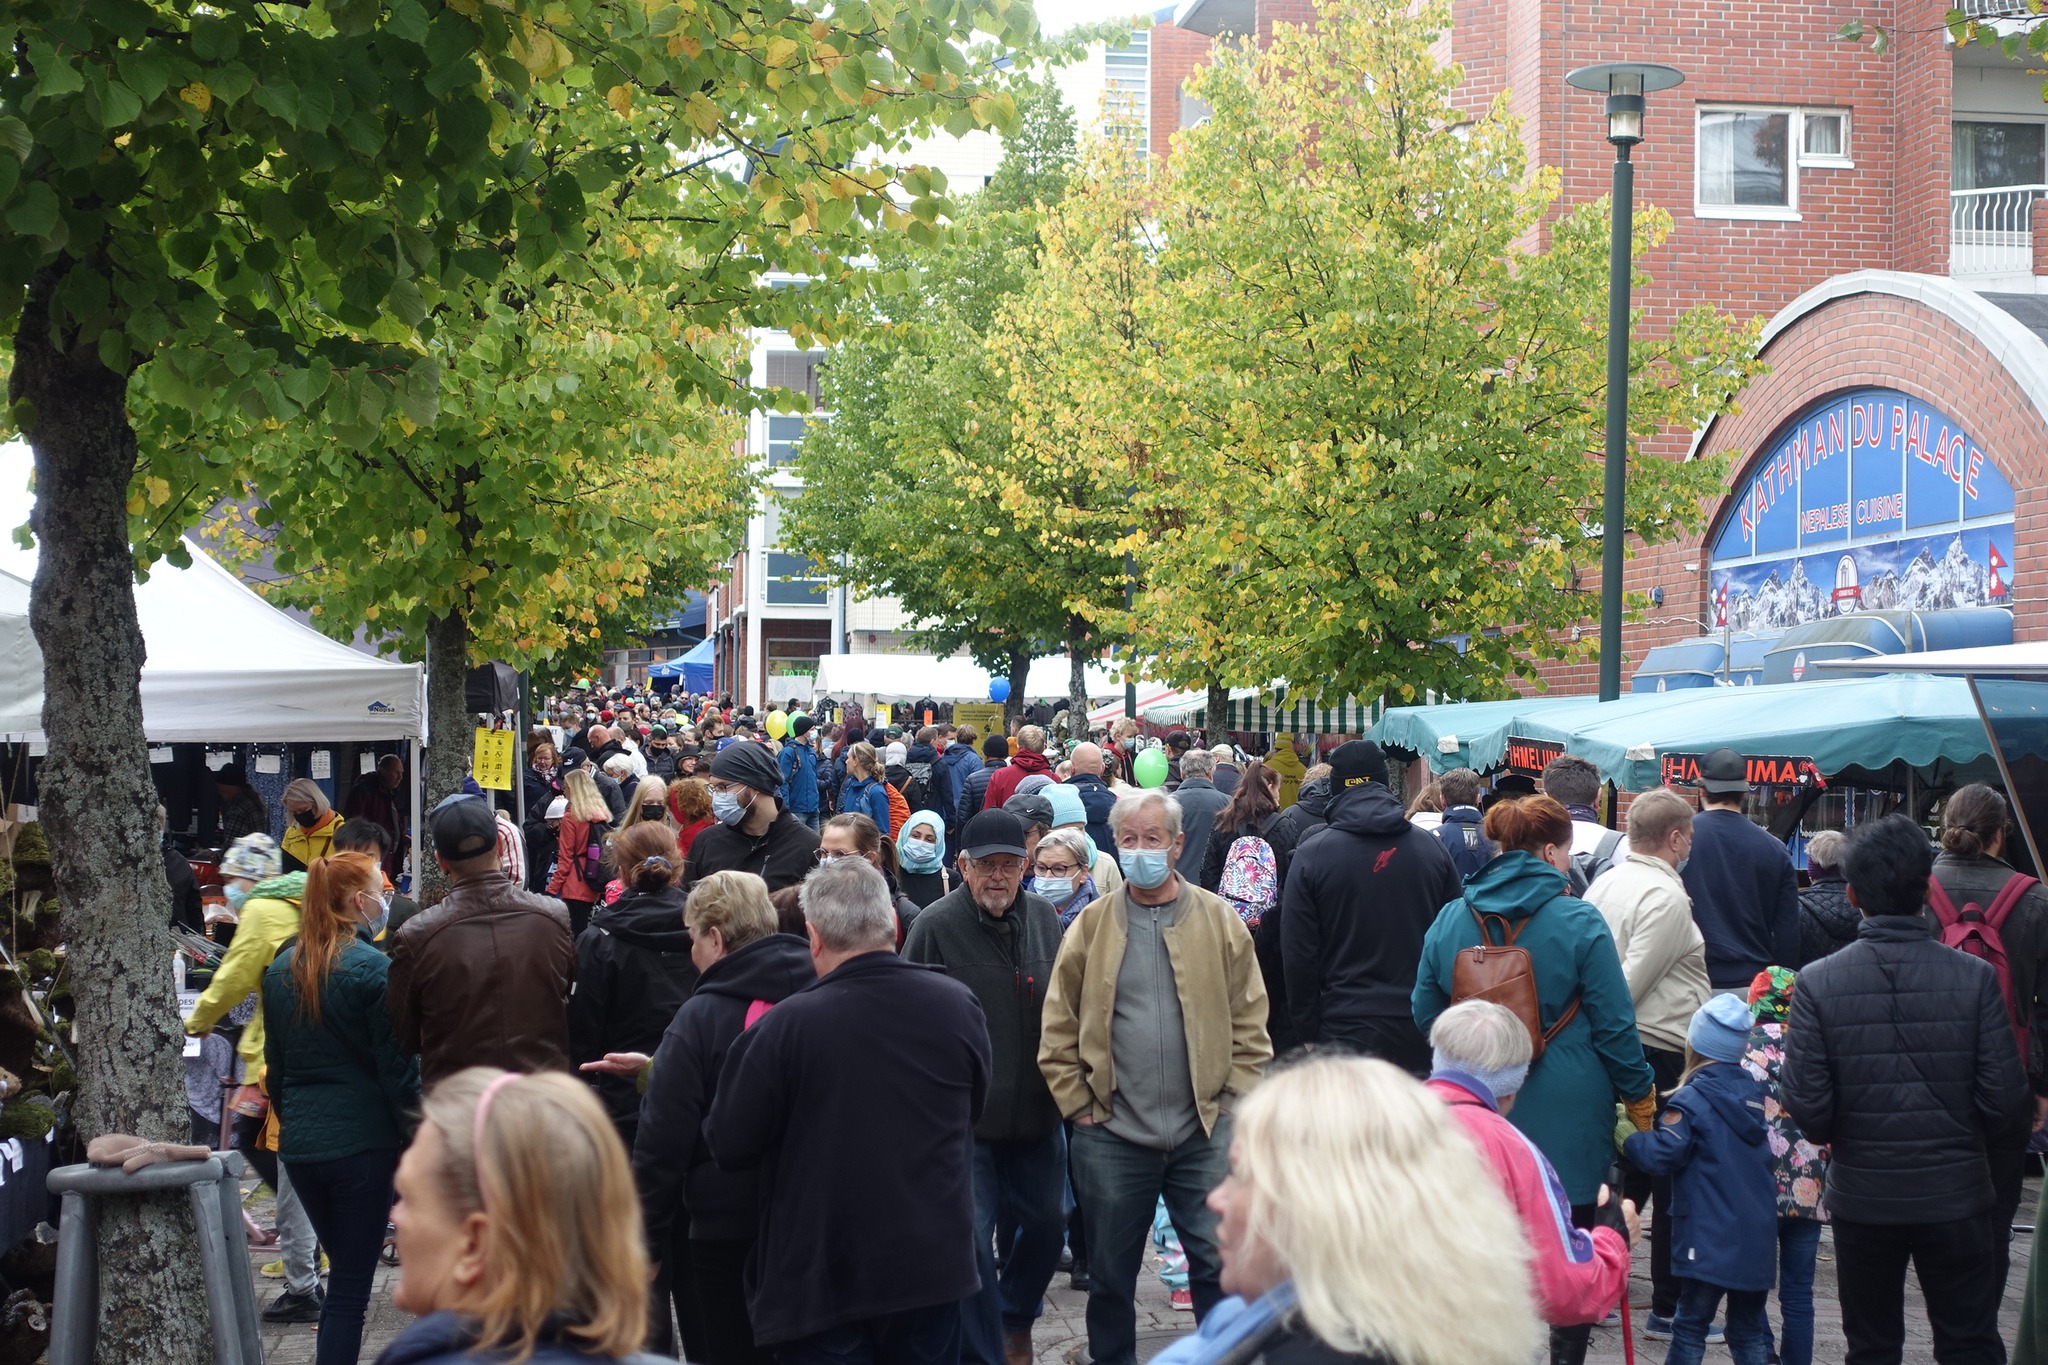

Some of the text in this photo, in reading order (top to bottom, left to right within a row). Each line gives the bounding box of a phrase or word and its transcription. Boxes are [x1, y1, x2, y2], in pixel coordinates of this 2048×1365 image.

[1891, 405, 1984, 500] PALACE
[1802, 493, 1903, 534] NEPALESE CUISINE
